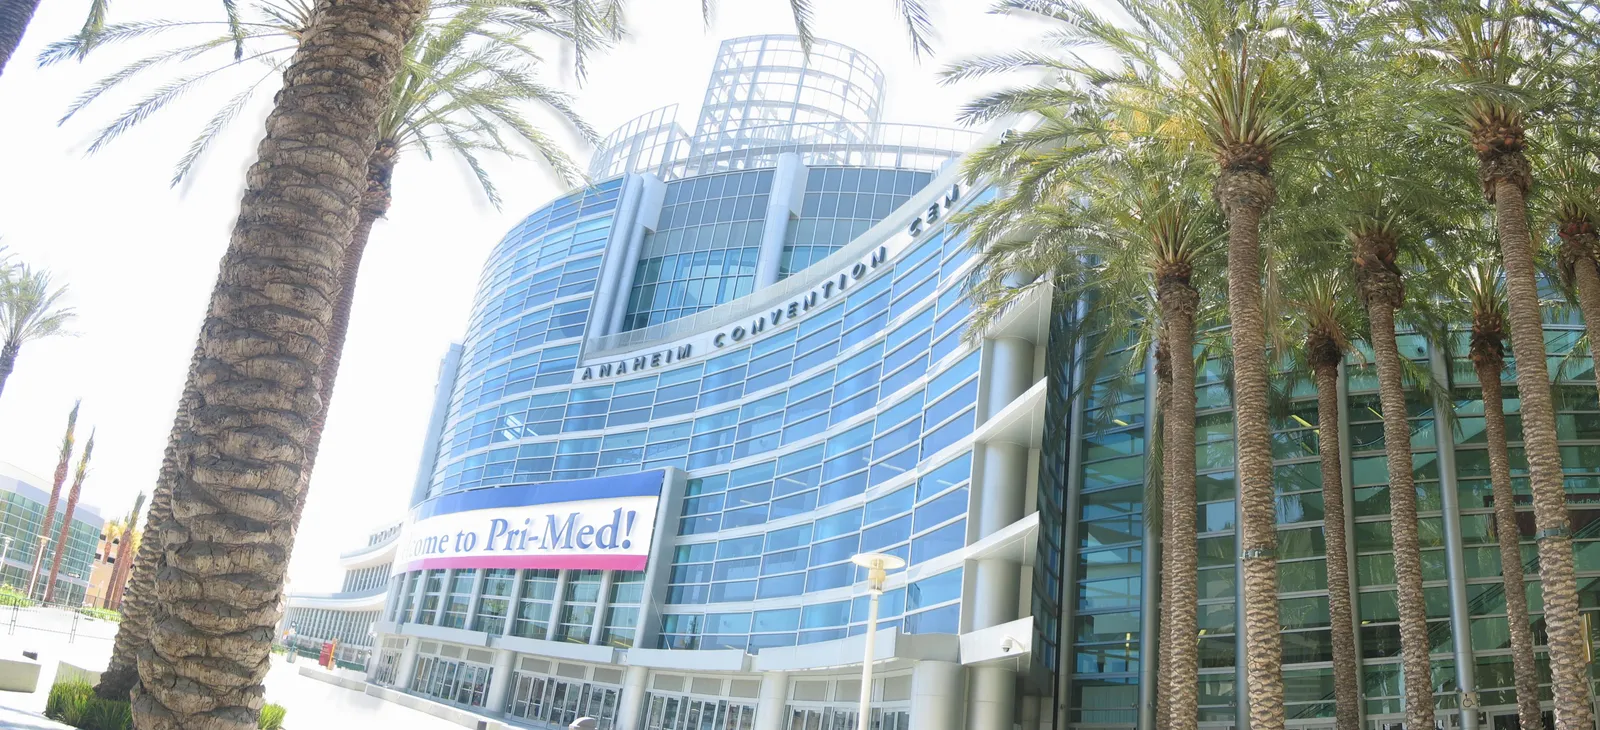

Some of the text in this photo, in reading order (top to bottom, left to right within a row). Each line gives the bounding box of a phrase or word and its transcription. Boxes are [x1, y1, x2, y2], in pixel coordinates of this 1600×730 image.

[581, 183, 960, 381] ANAHEIM CONVENTION CEN
[409, 507, 637, 557] come to Pri-Med!
